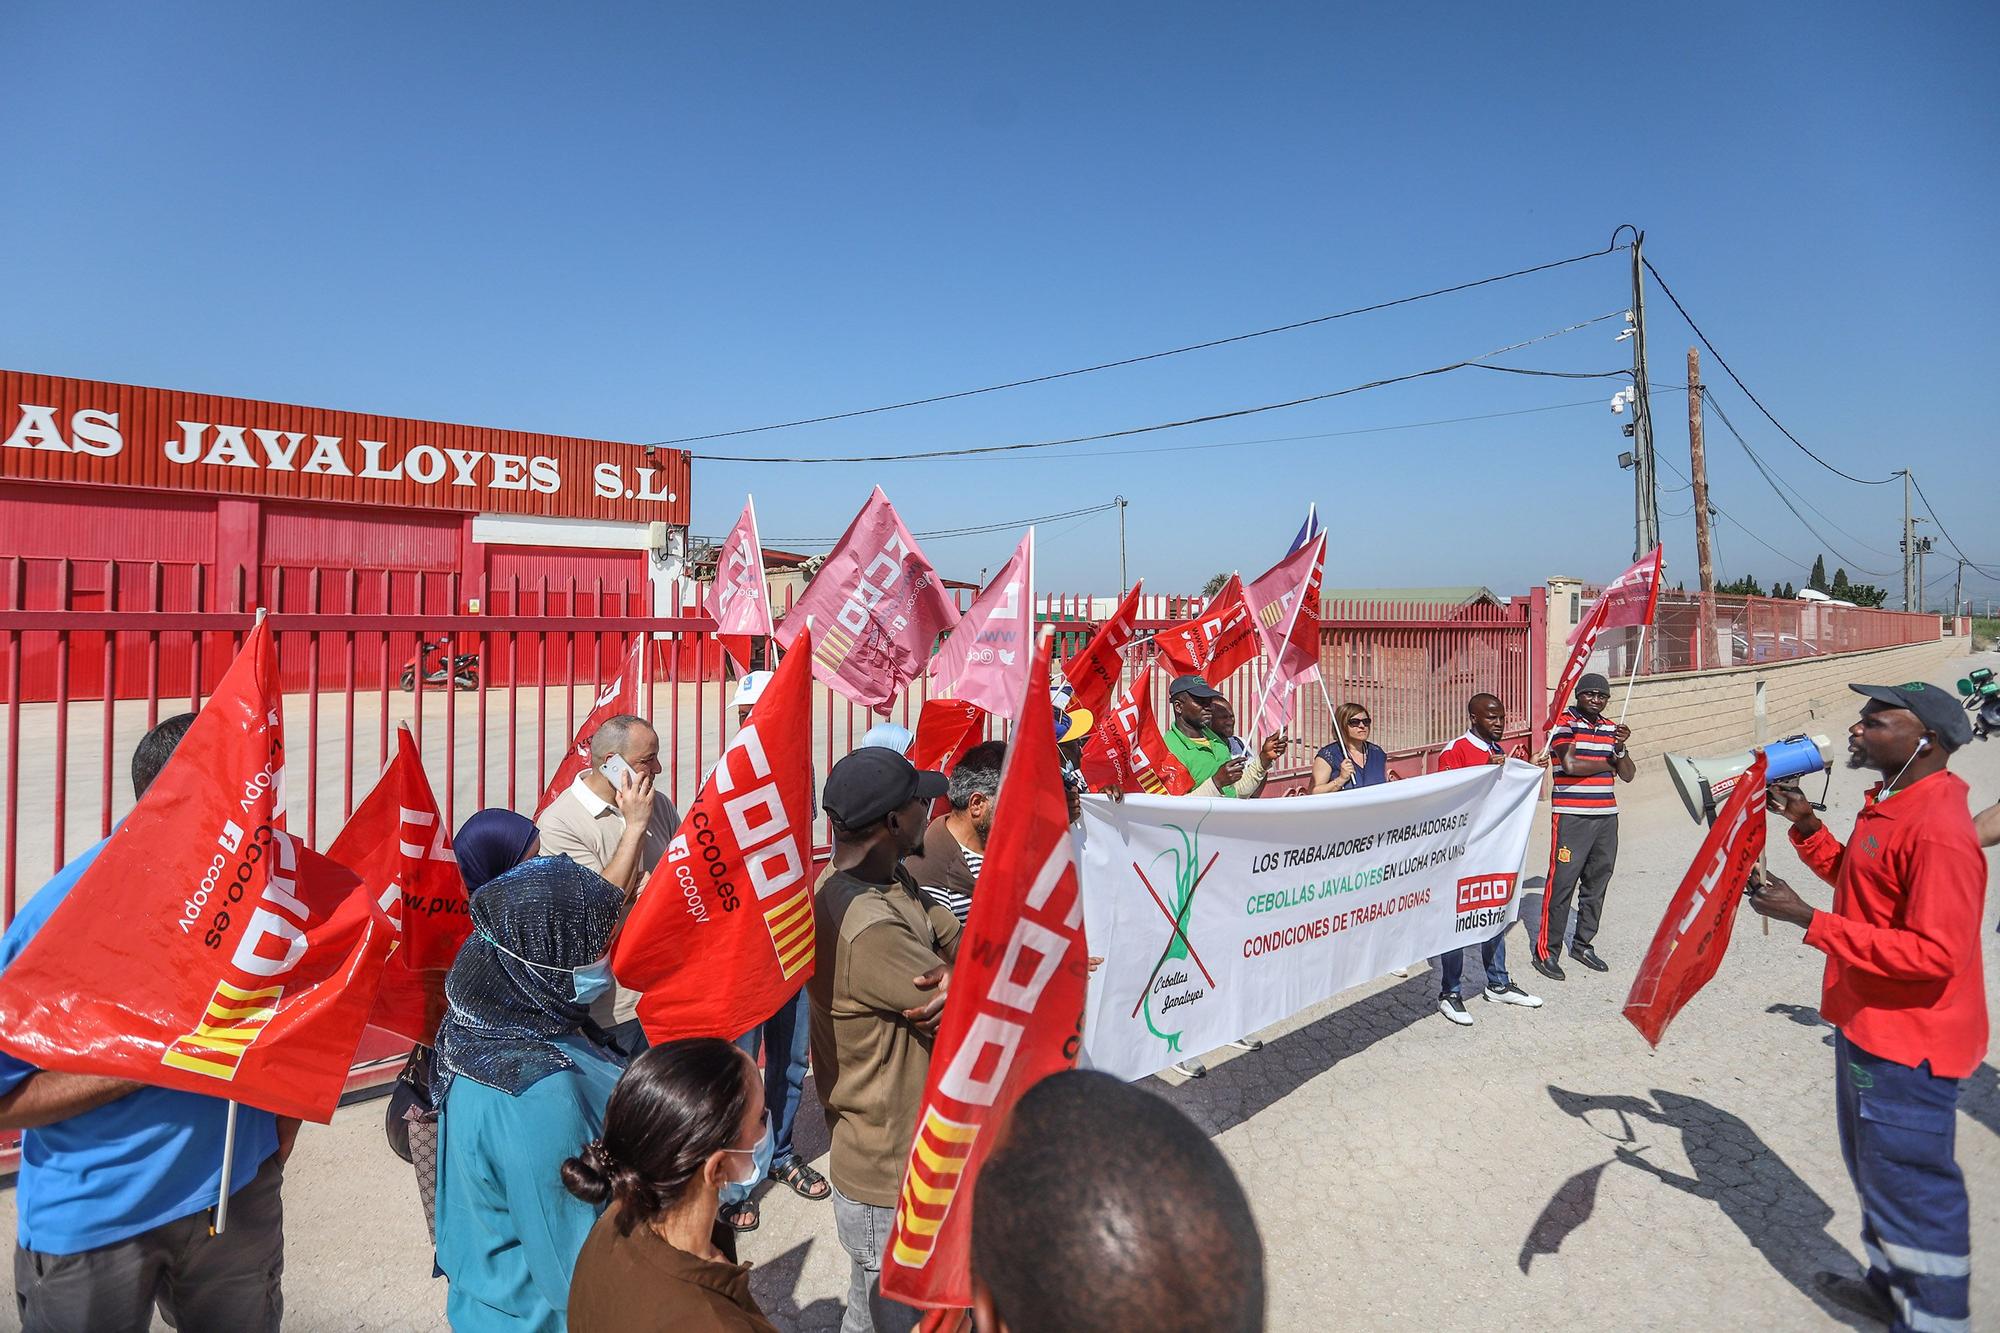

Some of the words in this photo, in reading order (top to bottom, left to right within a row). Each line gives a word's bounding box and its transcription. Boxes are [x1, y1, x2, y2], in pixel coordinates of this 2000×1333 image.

[1, 403, 124, 457] AS
[165, 420, 562, 494] JAVALOYES
[593, 463, 677, 503] S.L.
[715, 711, 805, 901] COO
[693, 797, 741, 913] .ccoo.es
[1252, 853, 1279, 874] LOS
[1282, 835, 1374, 869] TRABAJADORES
[1376, 832, 1385, 849] Y
[1385, 815, 1457, 846] TRABAJADORAS
[178, 853, 226, 935] ccoopv
[204, 814, 273, 950] .ccoo.es
[674, 865, 711, 924] ccoopv
[1246, 883, 1315, 916] CEBOLLAS
[1317, 867, 1384, 900] JAVALOYES
[1398, 853, 1429, 877] LUCHA
[1430, 848, 1447, 867] POR
[1459, 879, 1507, 904] CCOO
[1243, 917, 1330, 959] CONDICIONES
[1332, 912, 1348, 933] DE
[1350, 896, 1396, 928] TRABAJO
[1397, 887, 1432, 912] DIGNAS
[1455, 906, 1506, 933] indústria
[939, 831, 1086, 1107] COO
[1153, 971, 1188, 994] Cebollas
[1161, 988, 1204, 1015] Javaloyes
